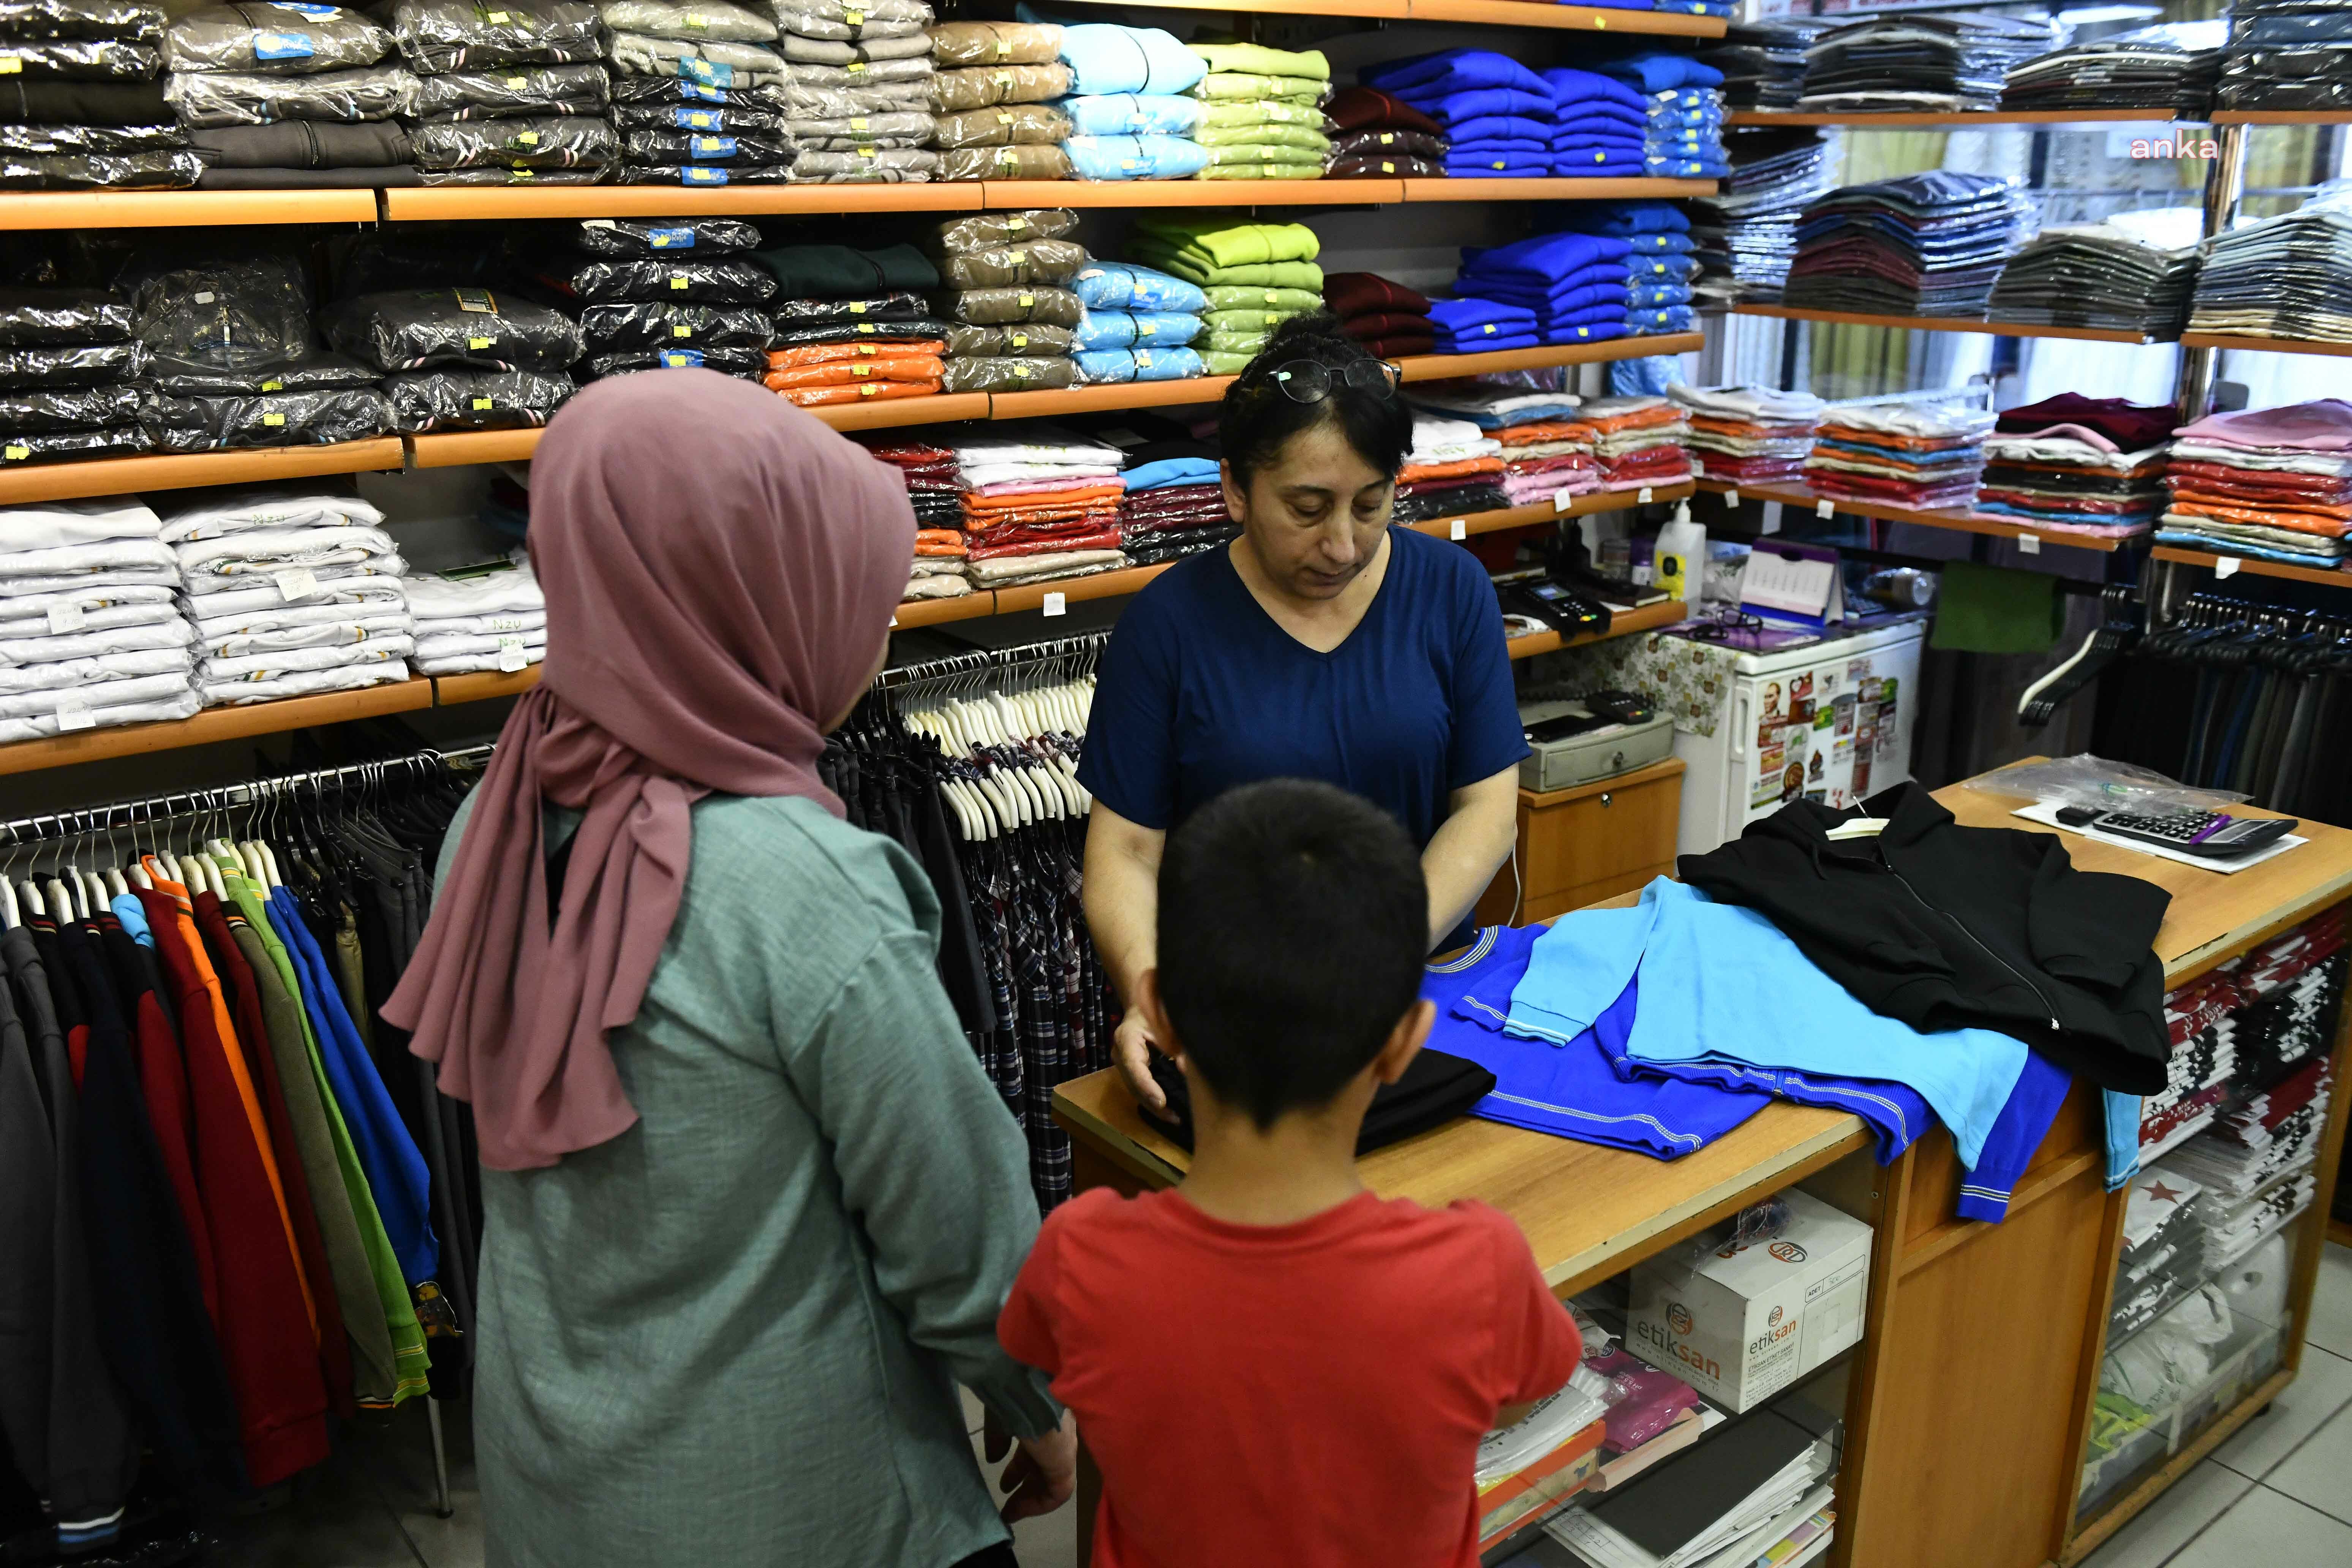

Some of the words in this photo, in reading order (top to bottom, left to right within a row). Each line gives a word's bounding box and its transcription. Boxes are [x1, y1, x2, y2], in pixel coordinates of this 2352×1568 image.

[1808, 1286, 1821, 1297] ADET
[1638, 1320, 1720, 1380] etiksan
[1750, 1320, 1796, 1355] etiksan
